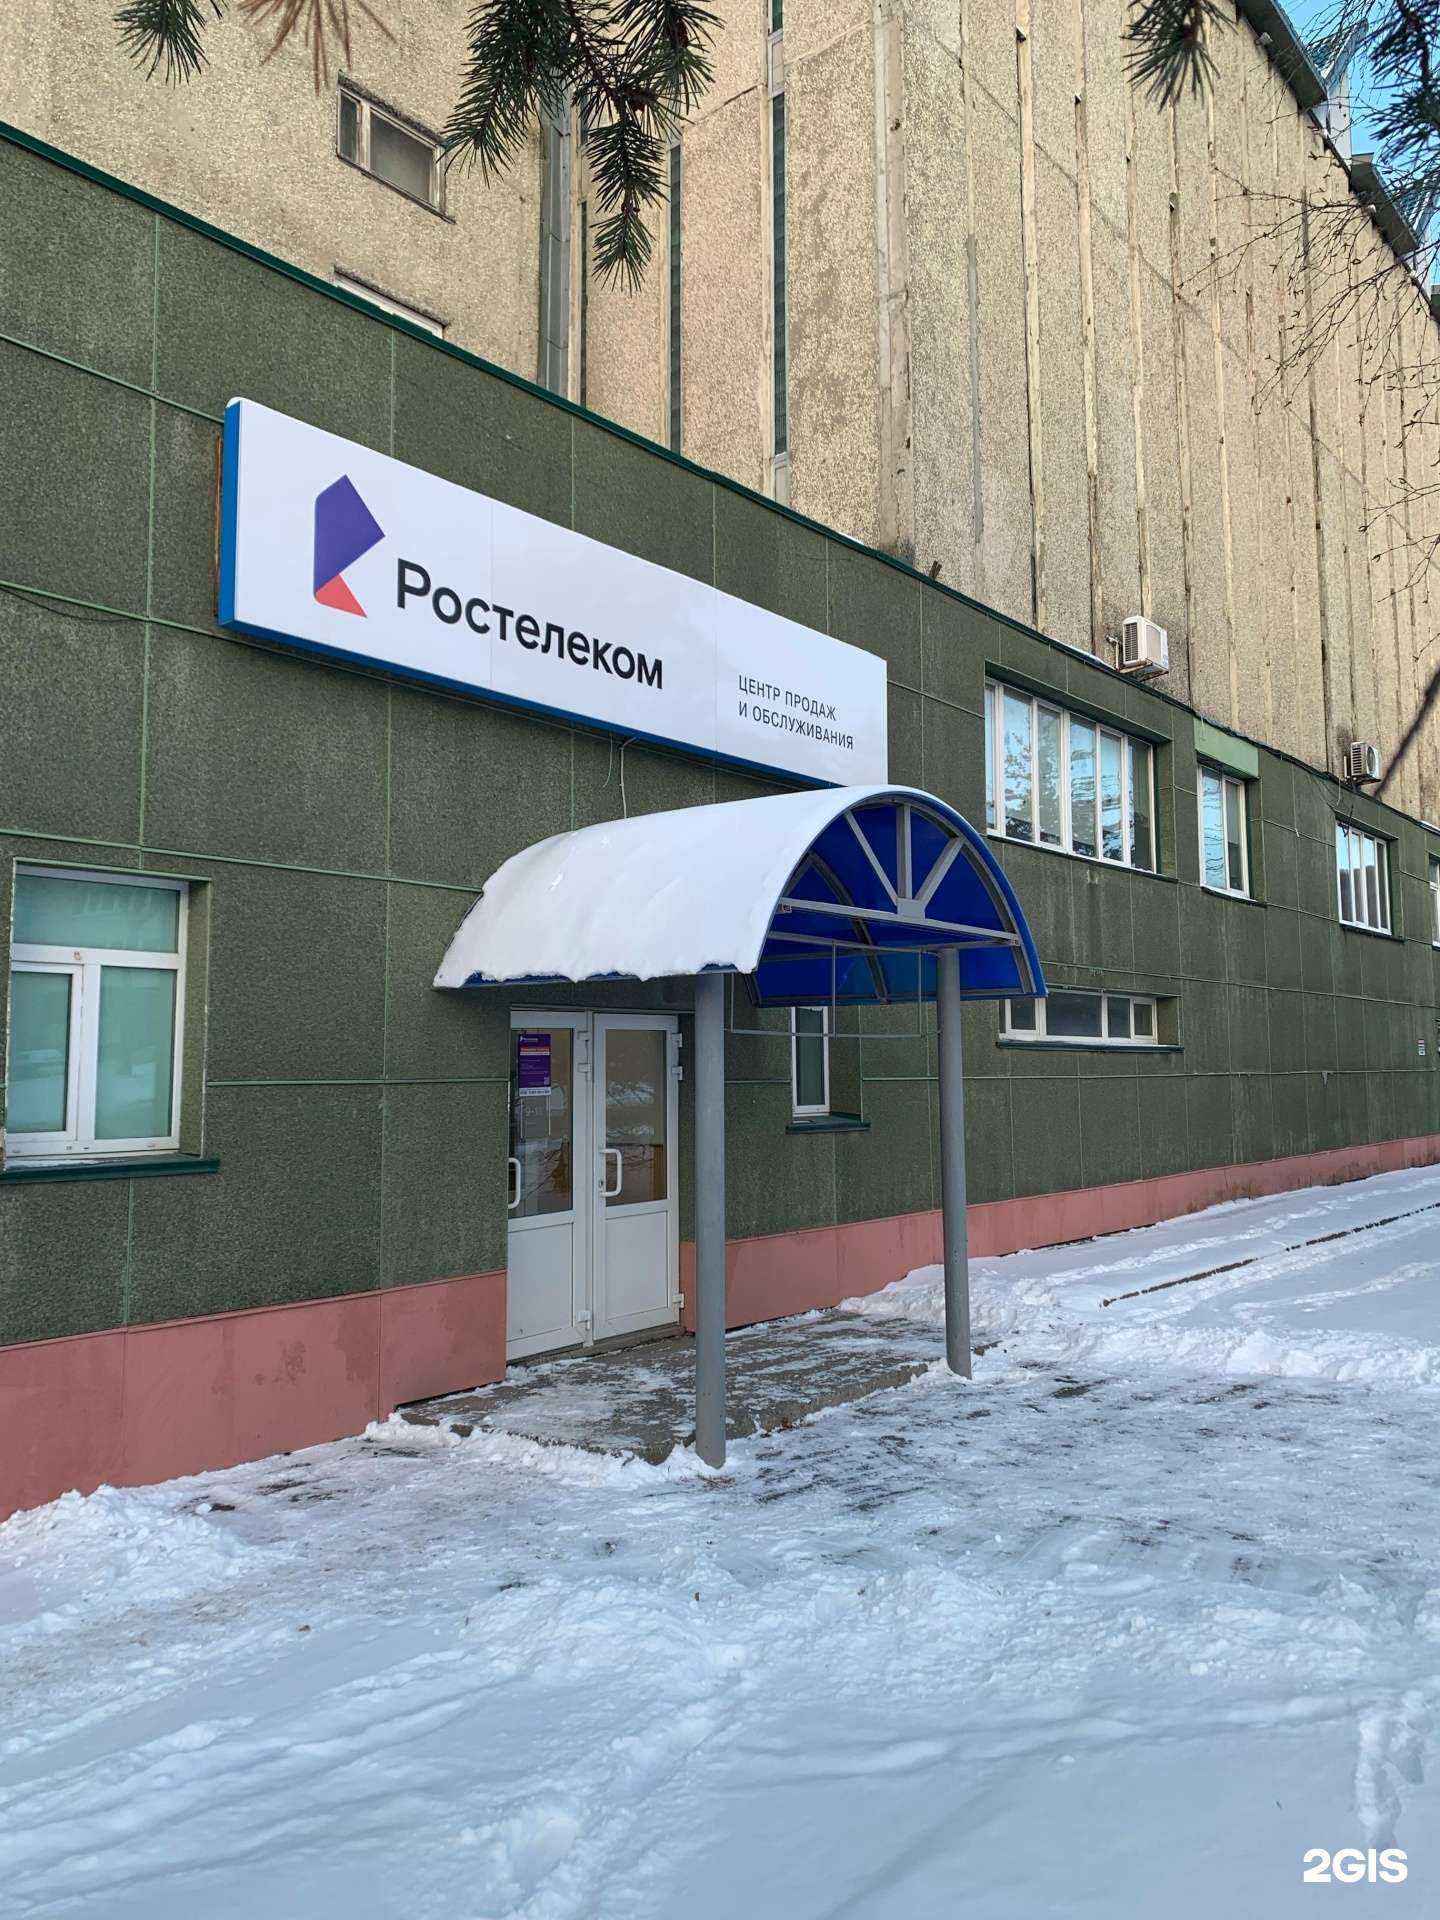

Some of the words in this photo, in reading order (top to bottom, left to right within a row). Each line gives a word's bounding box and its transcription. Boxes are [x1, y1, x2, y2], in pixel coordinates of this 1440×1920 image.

[397, 557, 663, 690] Ростелеком
[739, 674, 781, 701] ЦЕНТР
[785, 690, 837, 721] ПРОДАЖ
[739, 701, 748, 718] И
[752, 705, 854, 749] ОБСЛУЖИВАНИЯ
